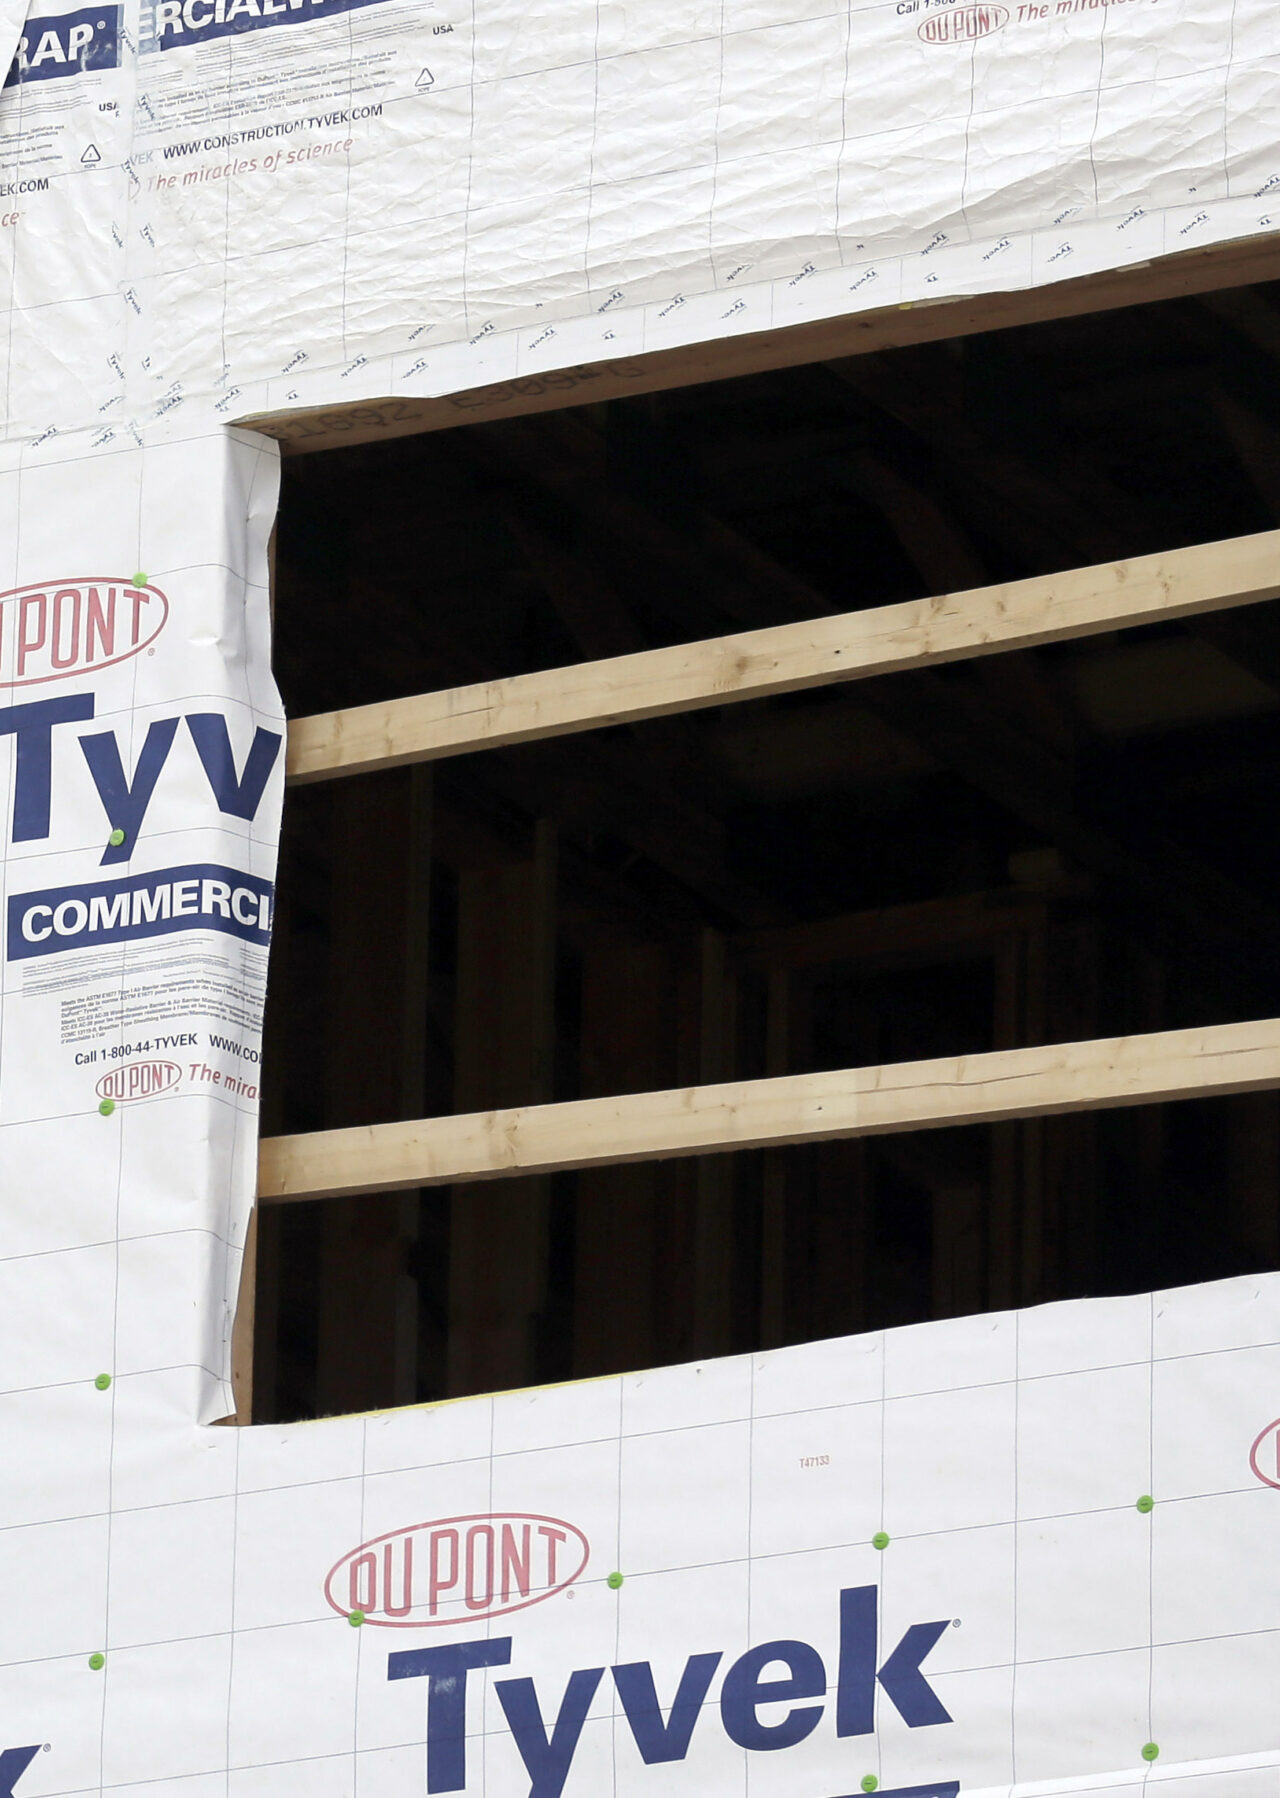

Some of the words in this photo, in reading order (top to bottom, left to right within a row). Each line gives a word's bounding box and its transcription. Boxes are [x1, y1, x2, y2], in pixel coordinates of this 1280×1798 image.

[433, 24, 454, 36] USA
[1016, 5, 1049, 23] The
[164, 103, 383, 160] WWW.CONSTRUCTION.TYVEK.COM
[182, 160, 258, 187] miracles
[263, 150, 285, 173] of
[286, 138, 354, 163] science
[75, 1050, 97, 1065] Call
[101, 1032, 198, 1060] 1-800-44-TYVEK
[102, 1063, 175, 1098] DUPONT
[189, 1063, 222, 1084] The
[348, 1519, 568, 1620] DUPONT
[387, 1583, 954, 1798] Tyvek
